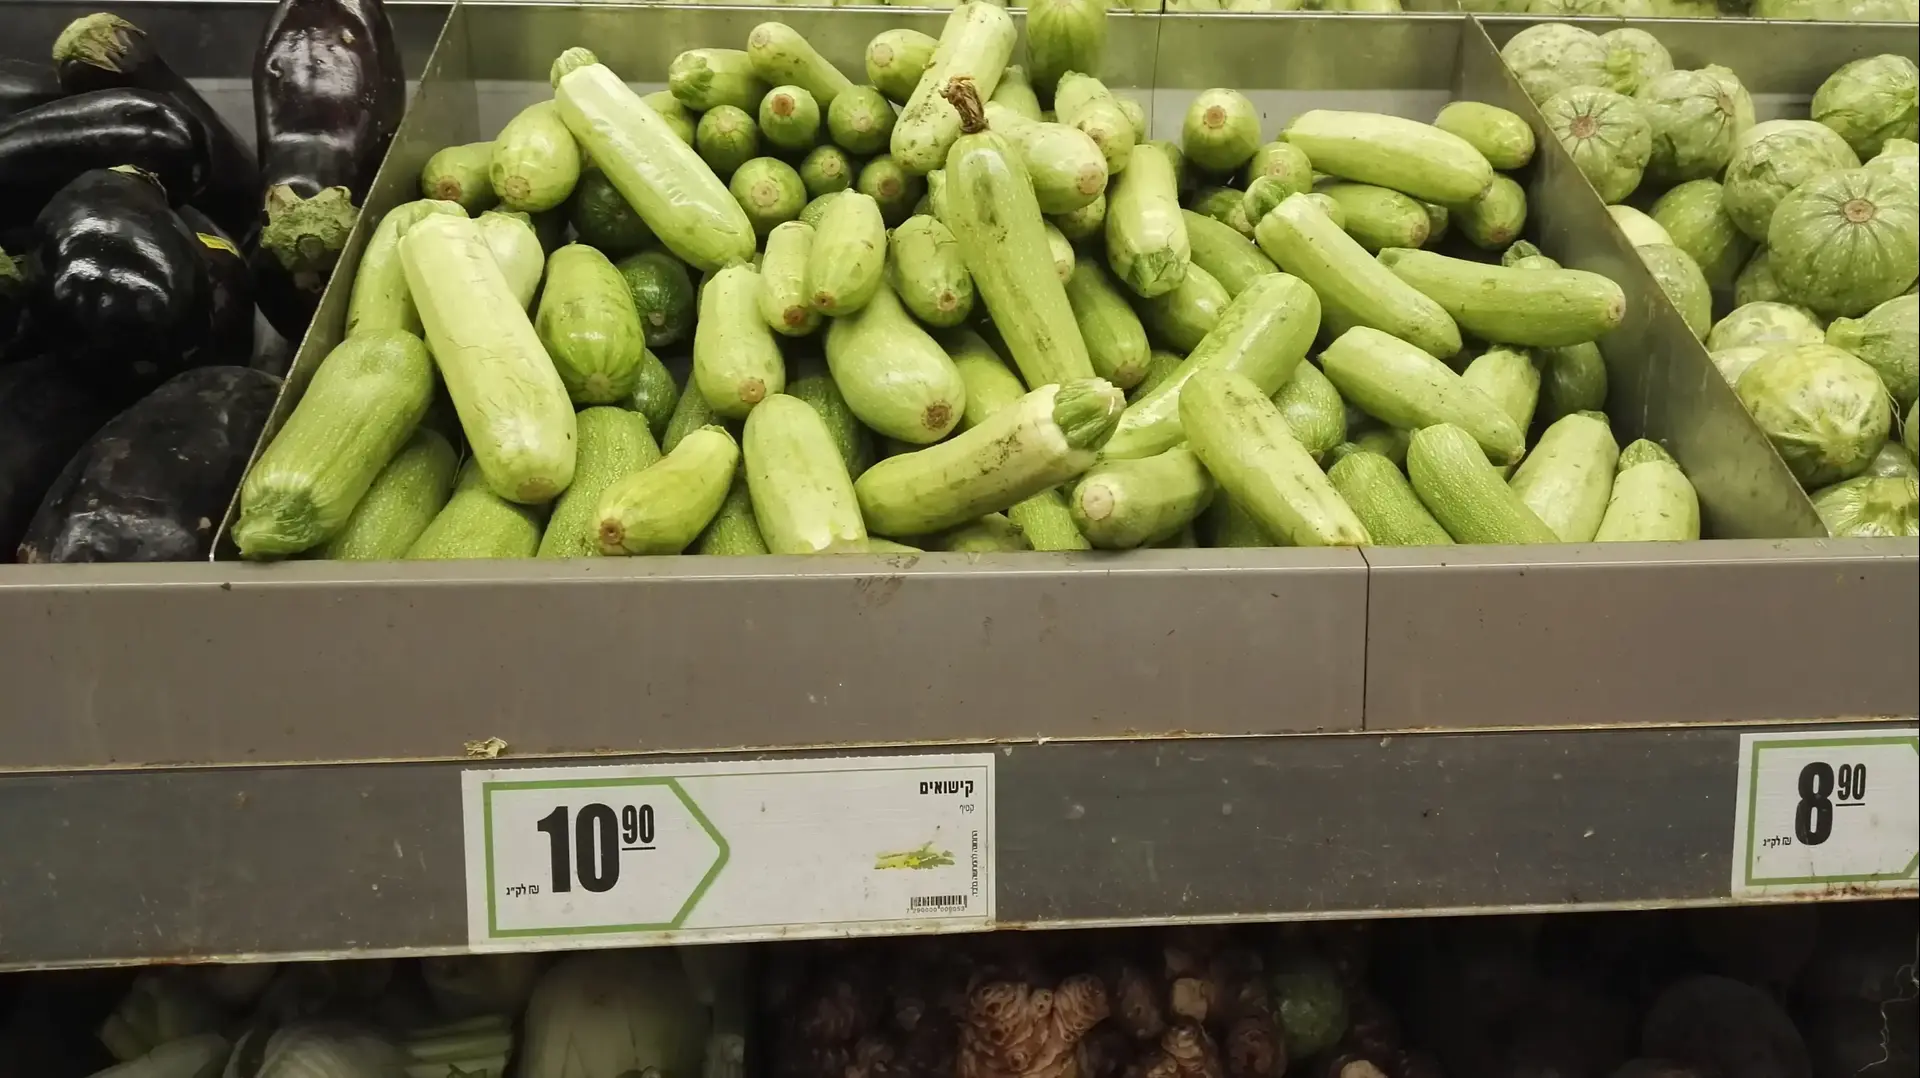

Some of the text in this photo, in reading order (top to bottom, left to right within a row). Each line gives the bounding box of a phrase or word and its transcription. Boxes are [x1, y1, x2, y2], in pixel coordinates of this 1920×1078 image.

[920, 780, 973, 797] קישואים
[1795, 762, 1866, 845] 8 90
[537, 803, 654, 893] 10 90
